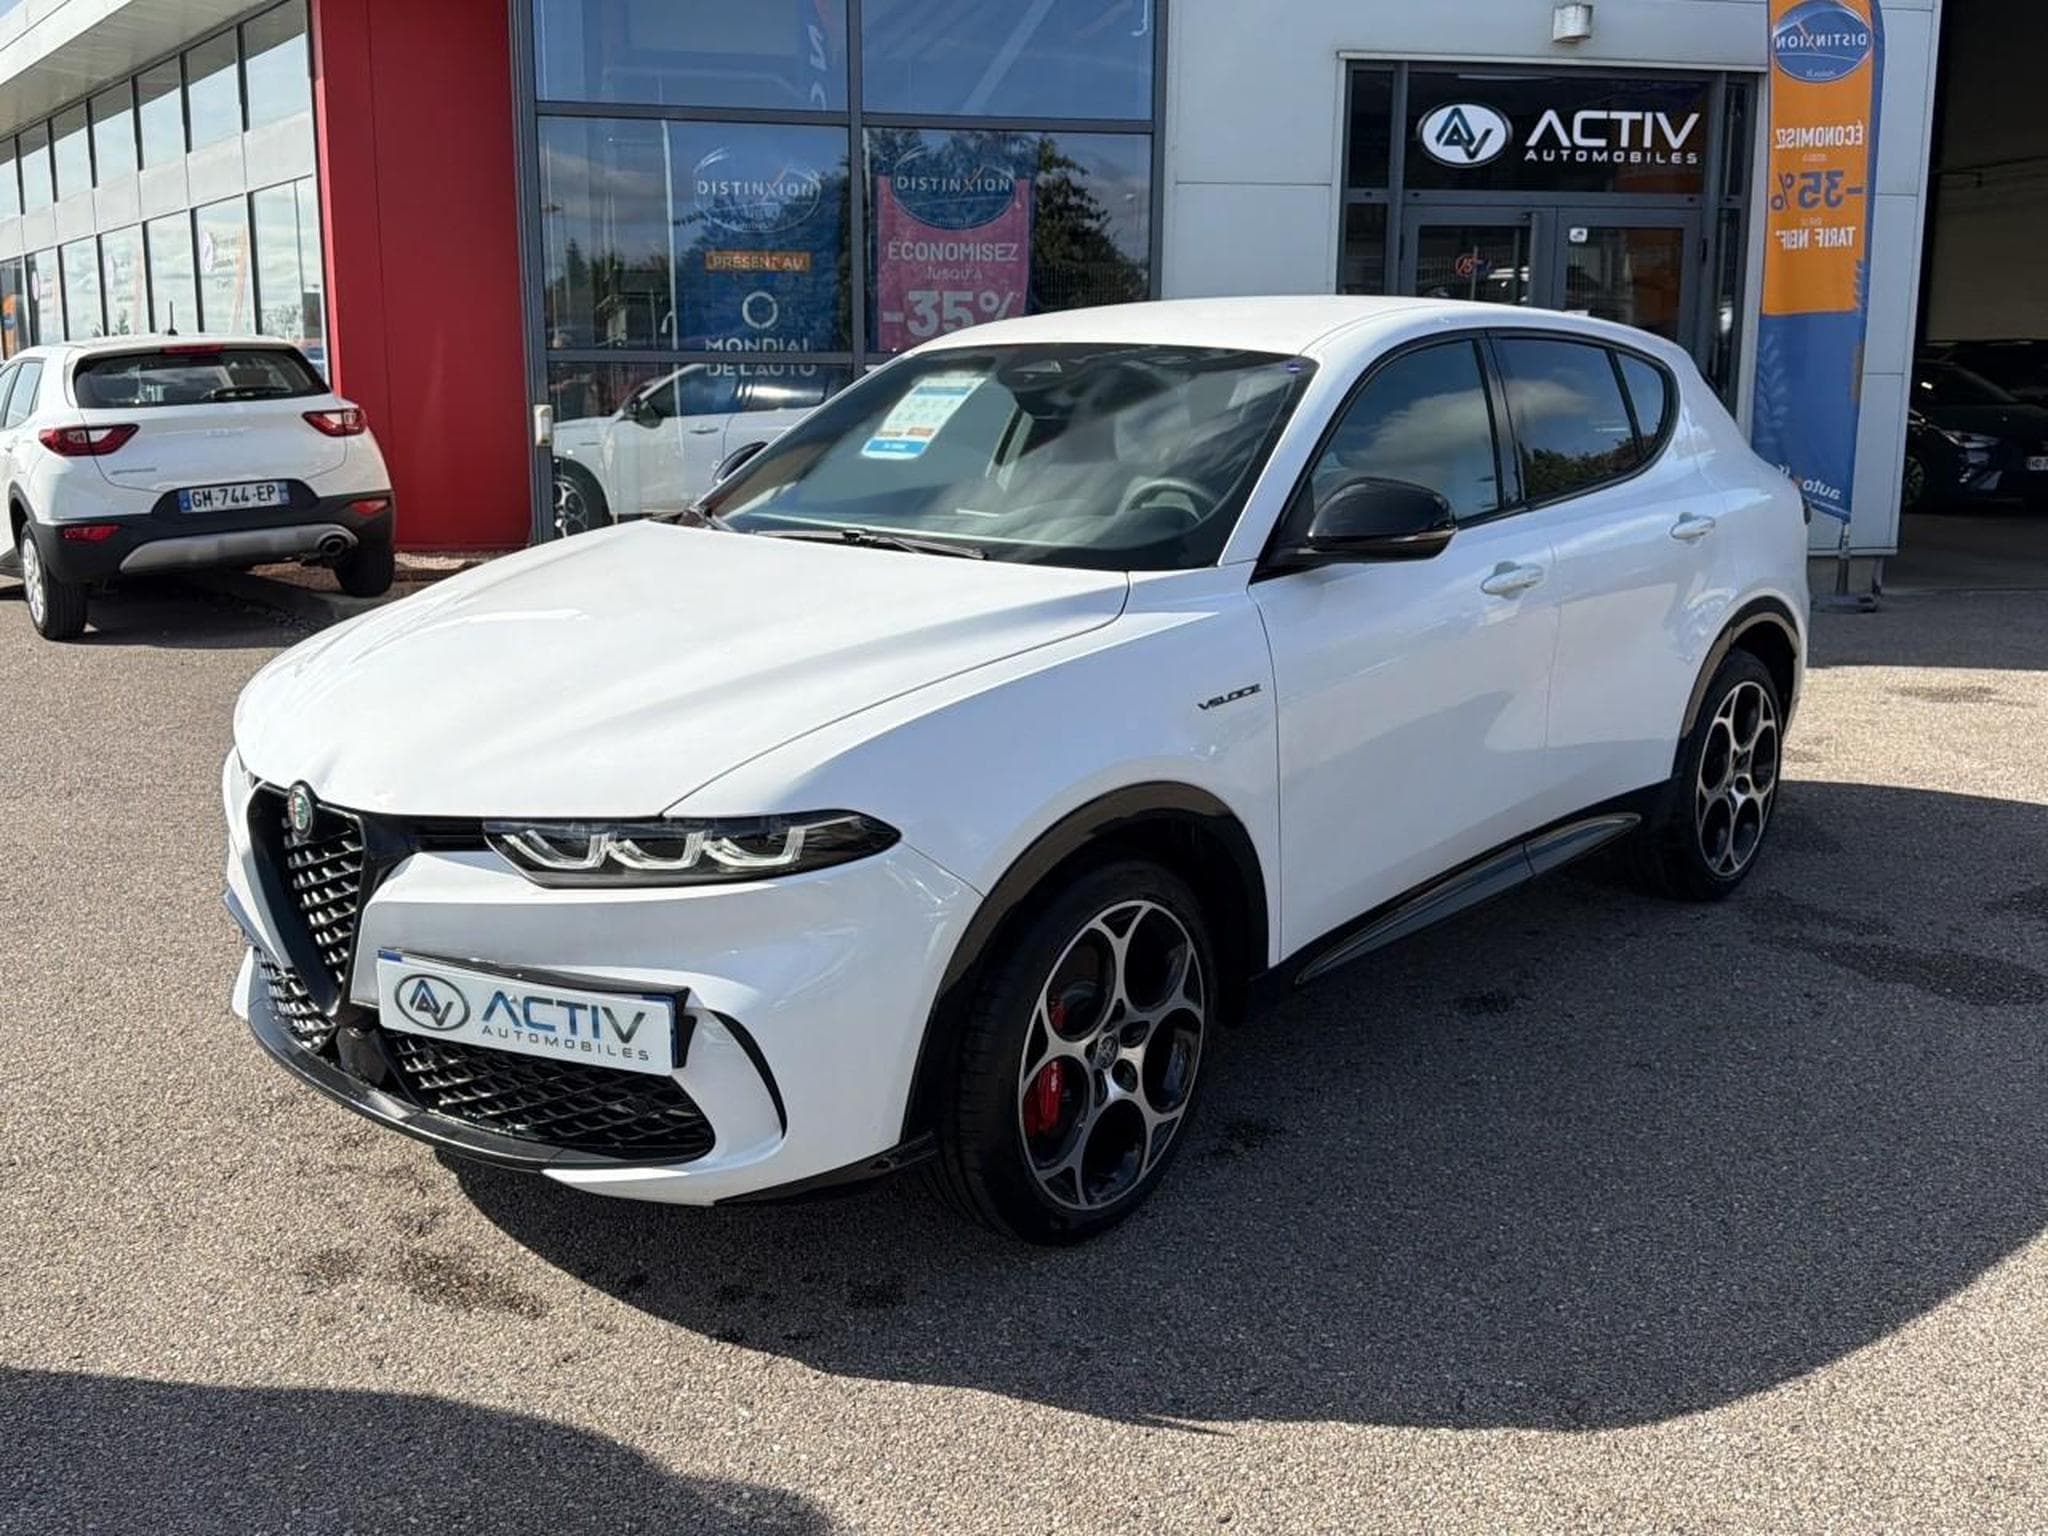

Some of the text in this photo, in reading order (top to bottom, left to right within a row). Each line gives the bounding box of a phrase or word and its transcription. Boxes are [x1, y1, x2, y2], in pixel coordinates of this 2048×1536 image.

[1525, 109, 1700, 149] ACTIV
[1524, 149, 1698, 164] AUTOMOBILES
[697, 180, 814, 197] DISTINXION
[897, 176, 1010, 193] DISTINXION
[888, 238, 1019, 262] ÉCONOMISEZ
[783, 256, 803, 270] AU
[482, 989, 646, 1043] ACTIV
[482, 1024, 650, 1061] AUTOMOBILES
